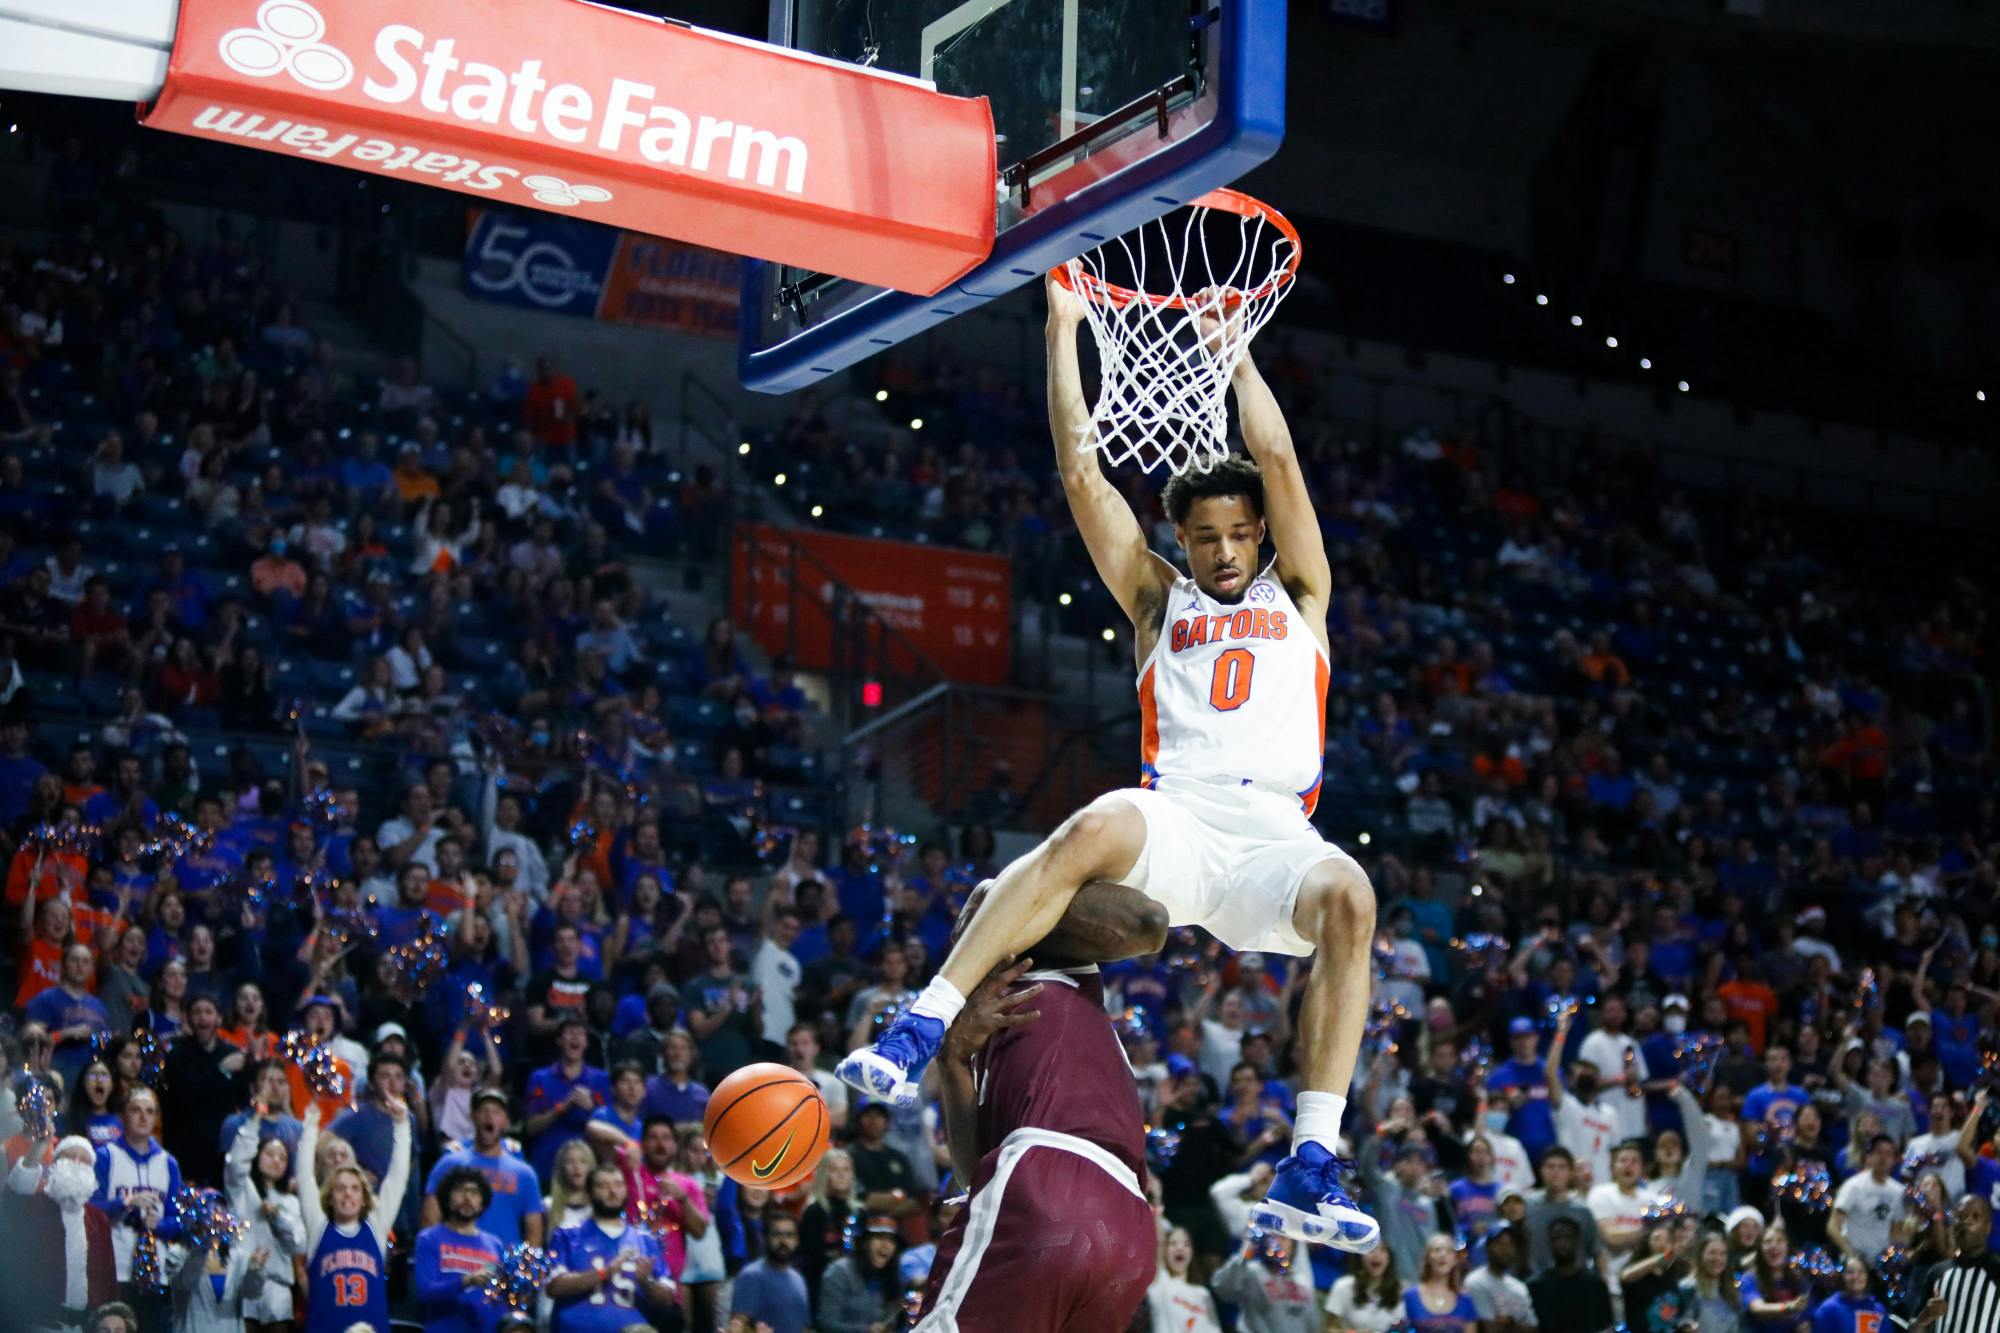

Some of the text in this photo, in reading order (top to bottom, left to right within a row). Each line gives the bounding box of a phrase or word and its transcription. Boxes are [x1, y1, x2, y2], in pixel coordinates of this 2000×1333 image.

[1171, 608, 1287, 653] GATORS
[1209, 647, 1255, 712] 0
[333, 1273, 368, 1307] 13
